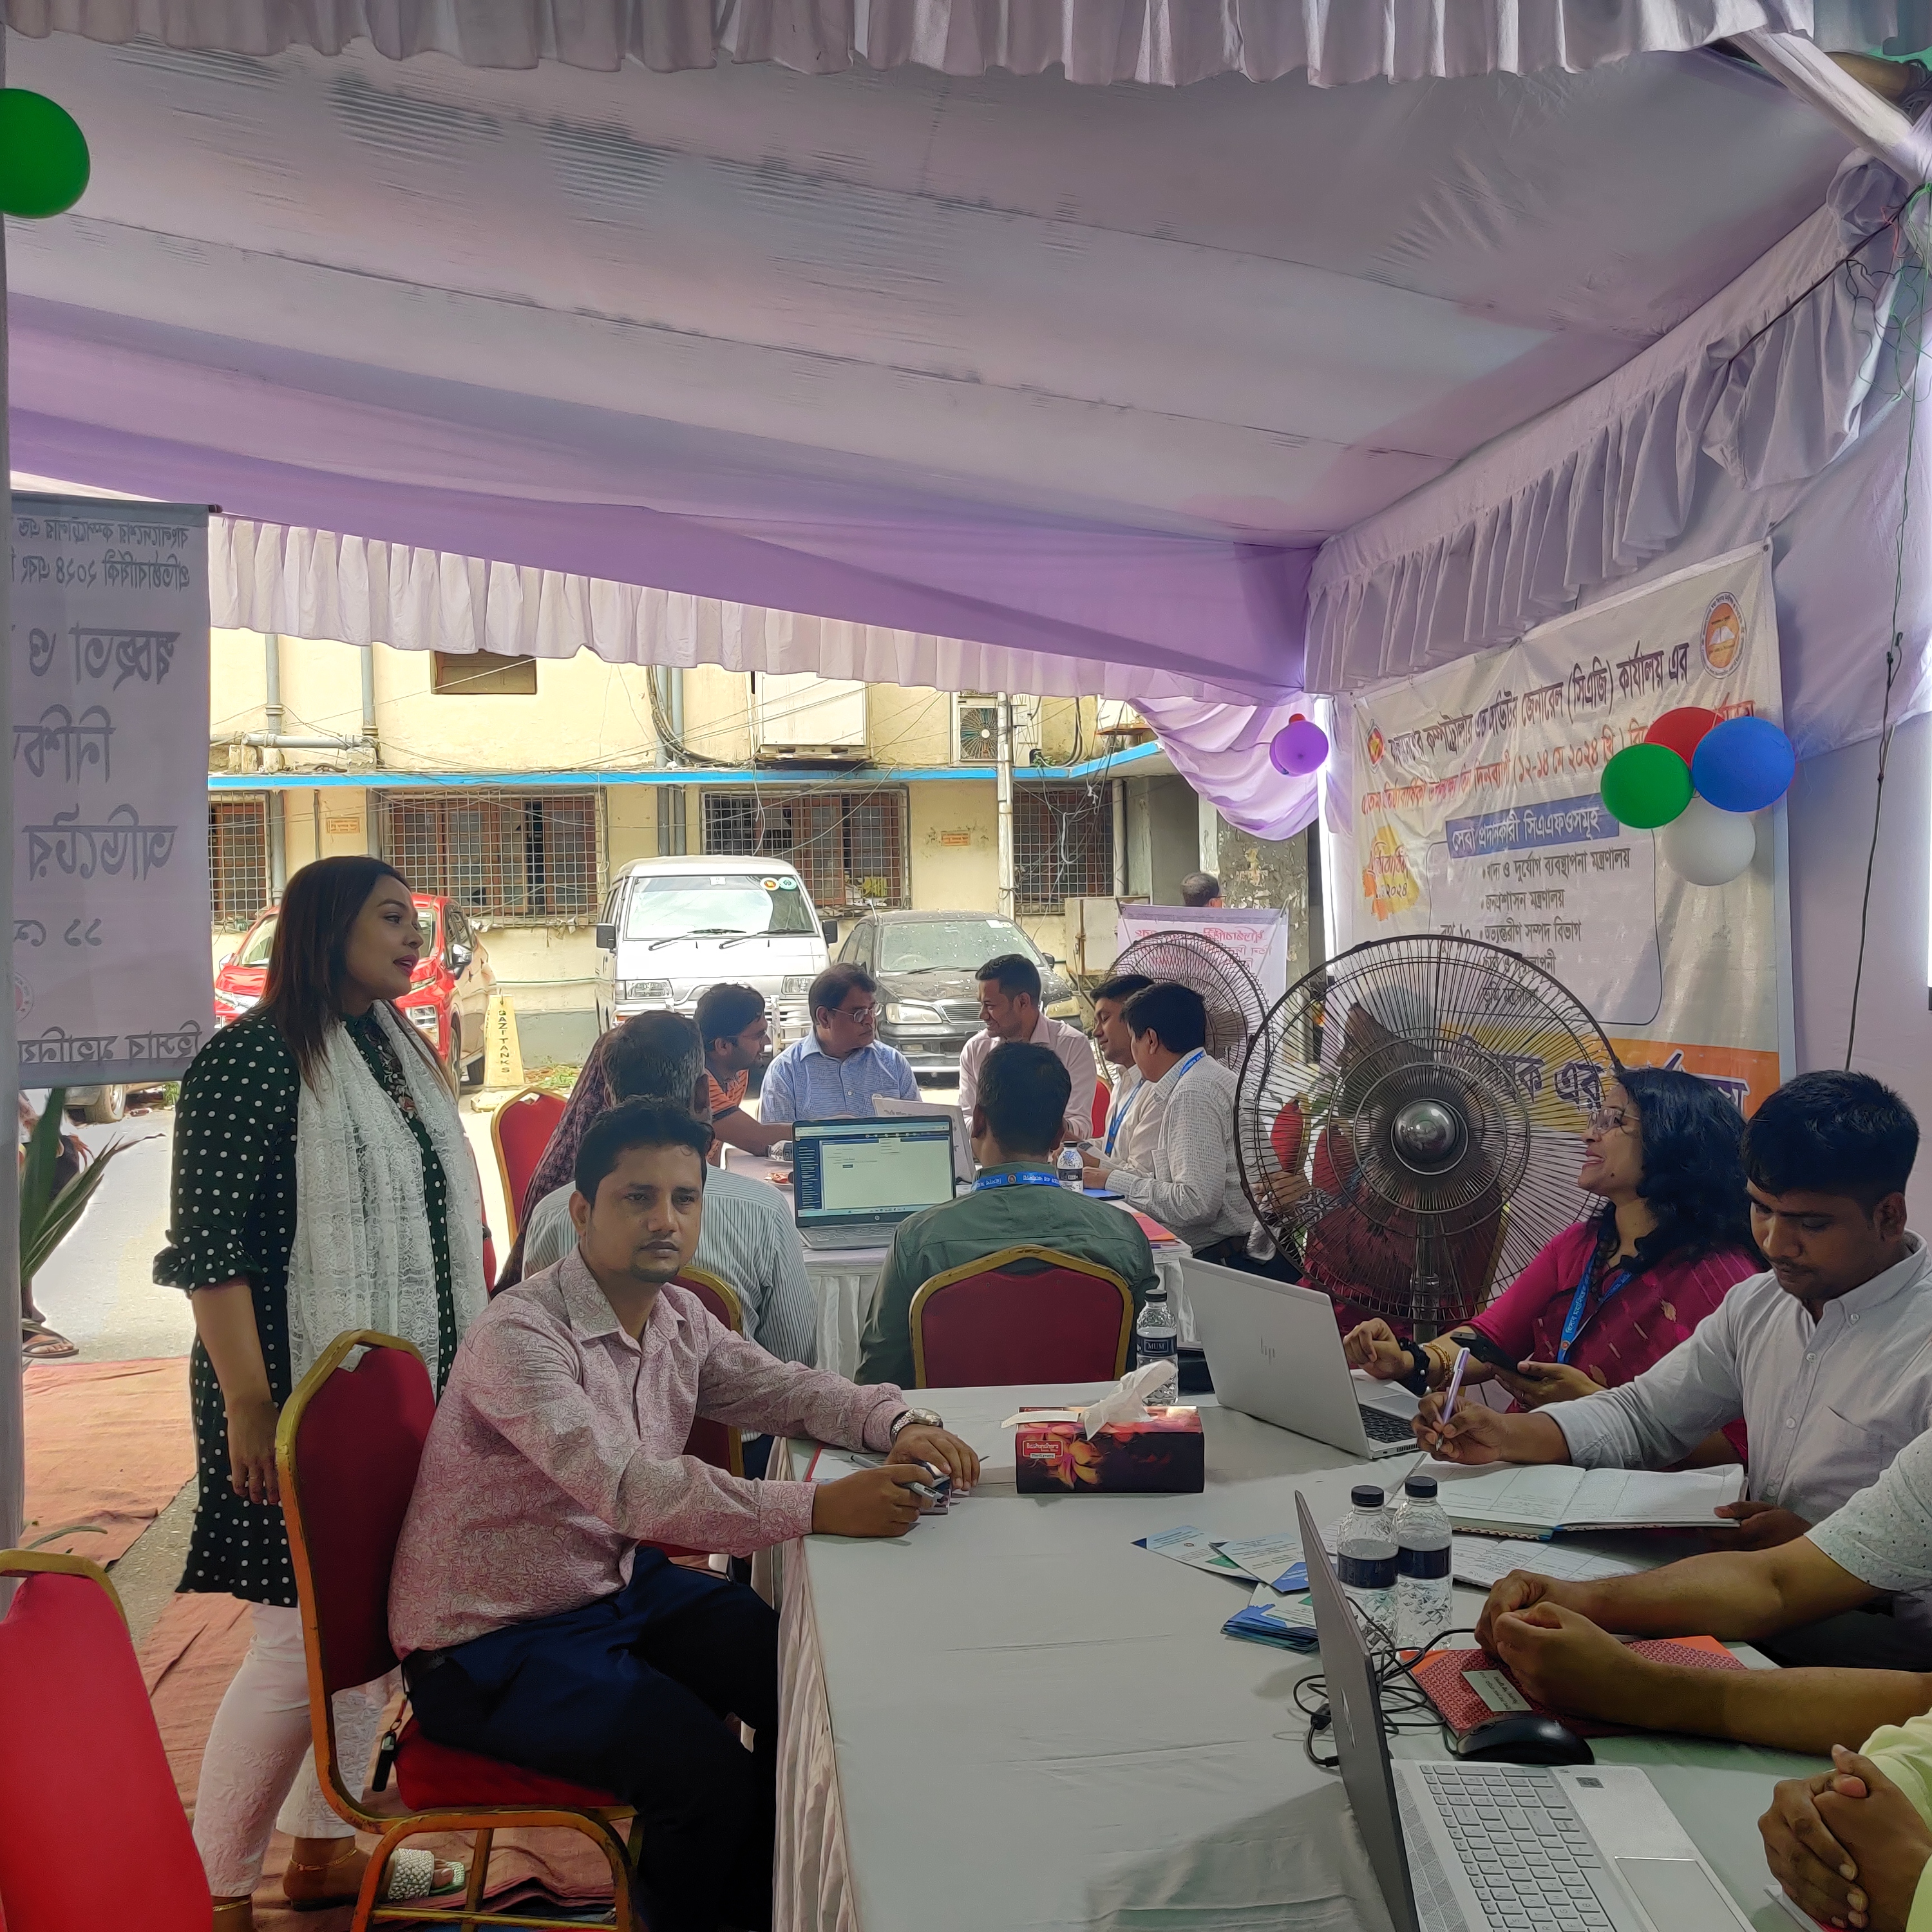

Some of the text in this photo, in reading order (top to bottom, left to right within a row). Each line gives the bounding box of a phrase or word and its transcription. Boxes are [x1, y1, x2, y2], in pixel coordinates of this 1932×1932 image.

[1521, 681, 1564, 726] জেনারেল
[1567, 656, 1614, 724] (সিএজি)
[1616, 640, 1664, 699] কার্যালয়
[1668, 641, 1689, 685] এর
[1553, 745, 1565, 775] মে
[1567, 736, 1599, 773] ২০২৪
[1452, 806, 1601, 853] সেবা প্রদানকারী সিএএফওসমূহ
[1502, 862, 1510, 878] ও
[1513, 851, 1542, 884] দুর্যোগ
[1544, 851, 1588, 880] ব্যবস্থাপনা
[1590, 846, 1631, 872] মন্ত্রণালয়
[1485, 887, 1566, 913] জনপ্রশাসন মন্ত্রণালয়
[1523, 920, 1553, 943] সম্পদ
[1553, 915, 1582, 943] বিভাগ
[498, 1009, 511, 1074] GAZI TANKS
[1145, 1341, 1167, 1350] MUM
